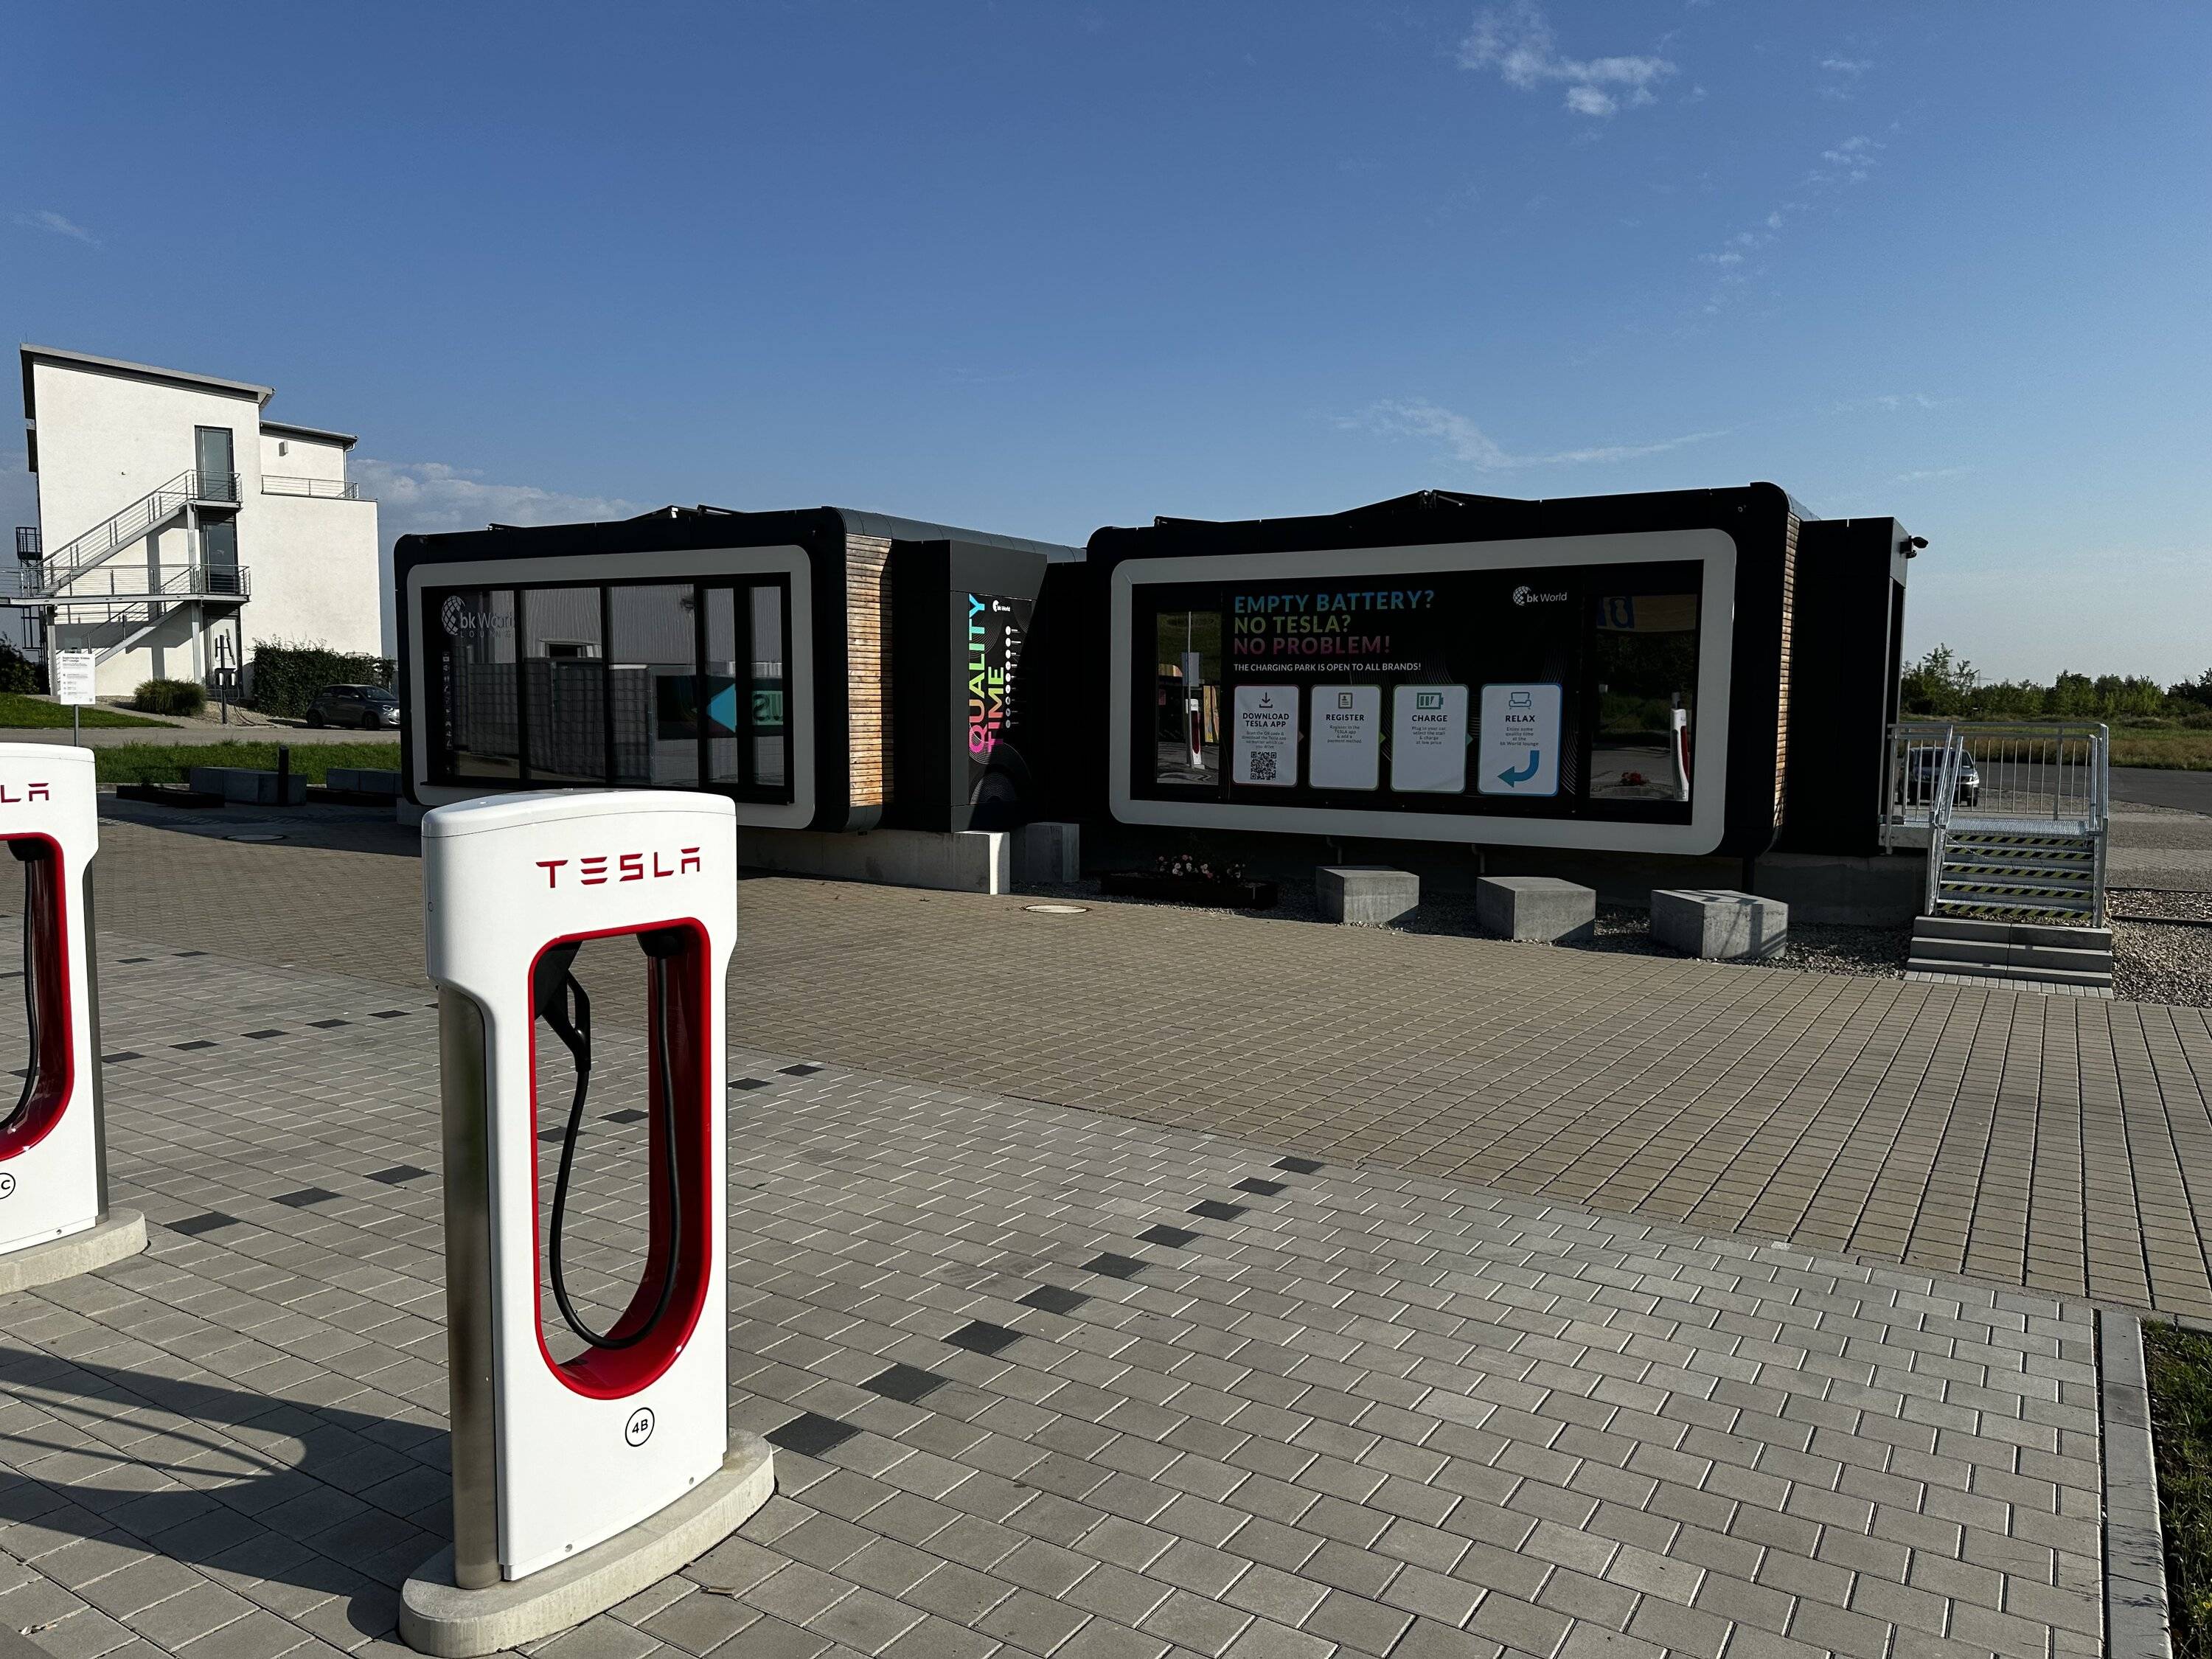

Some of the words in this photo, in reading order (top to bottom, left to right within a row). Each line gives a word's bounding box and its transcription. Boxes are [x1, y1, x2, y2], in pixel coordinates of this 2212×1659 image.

[1234, 594, 1310, 613] EMPTY
[1316, 590, 1435, 612] BATTERY?
[1526, 594, 1539, 602] bk
[1540, 591, 1568, 602] World
[460, 612, 476, 629] bk
[478, 611, 515, 629] Worl
[1234, 616, 1267, 634] NO
[1273, 614, 1352, 634] TESLA?
[1234, 637, 1267, 655] NO
[1273, 636, 1391, 655] PROBLEM!
[968, 593, 987, 754] QUALITY
[1234, 664, 1249, 672] THE
[1251, 664, 1293, 672] CHARGING
[1295, 664, 1316, 672] PARK
[1326, 663, 1350, 672] OPEN
[1352, 663, 1363, 672] TO
[1365, 663, 1381, 671] ALL
[1382, 662, 1422, 671] BRANDS!
[988, 666, 1004, 753] TIME
[1242, 712, 1290, 720] DOWNLOAD
[535, 846, 700, 888] TESLA
[631, 1418, 649, 1434] 4B
